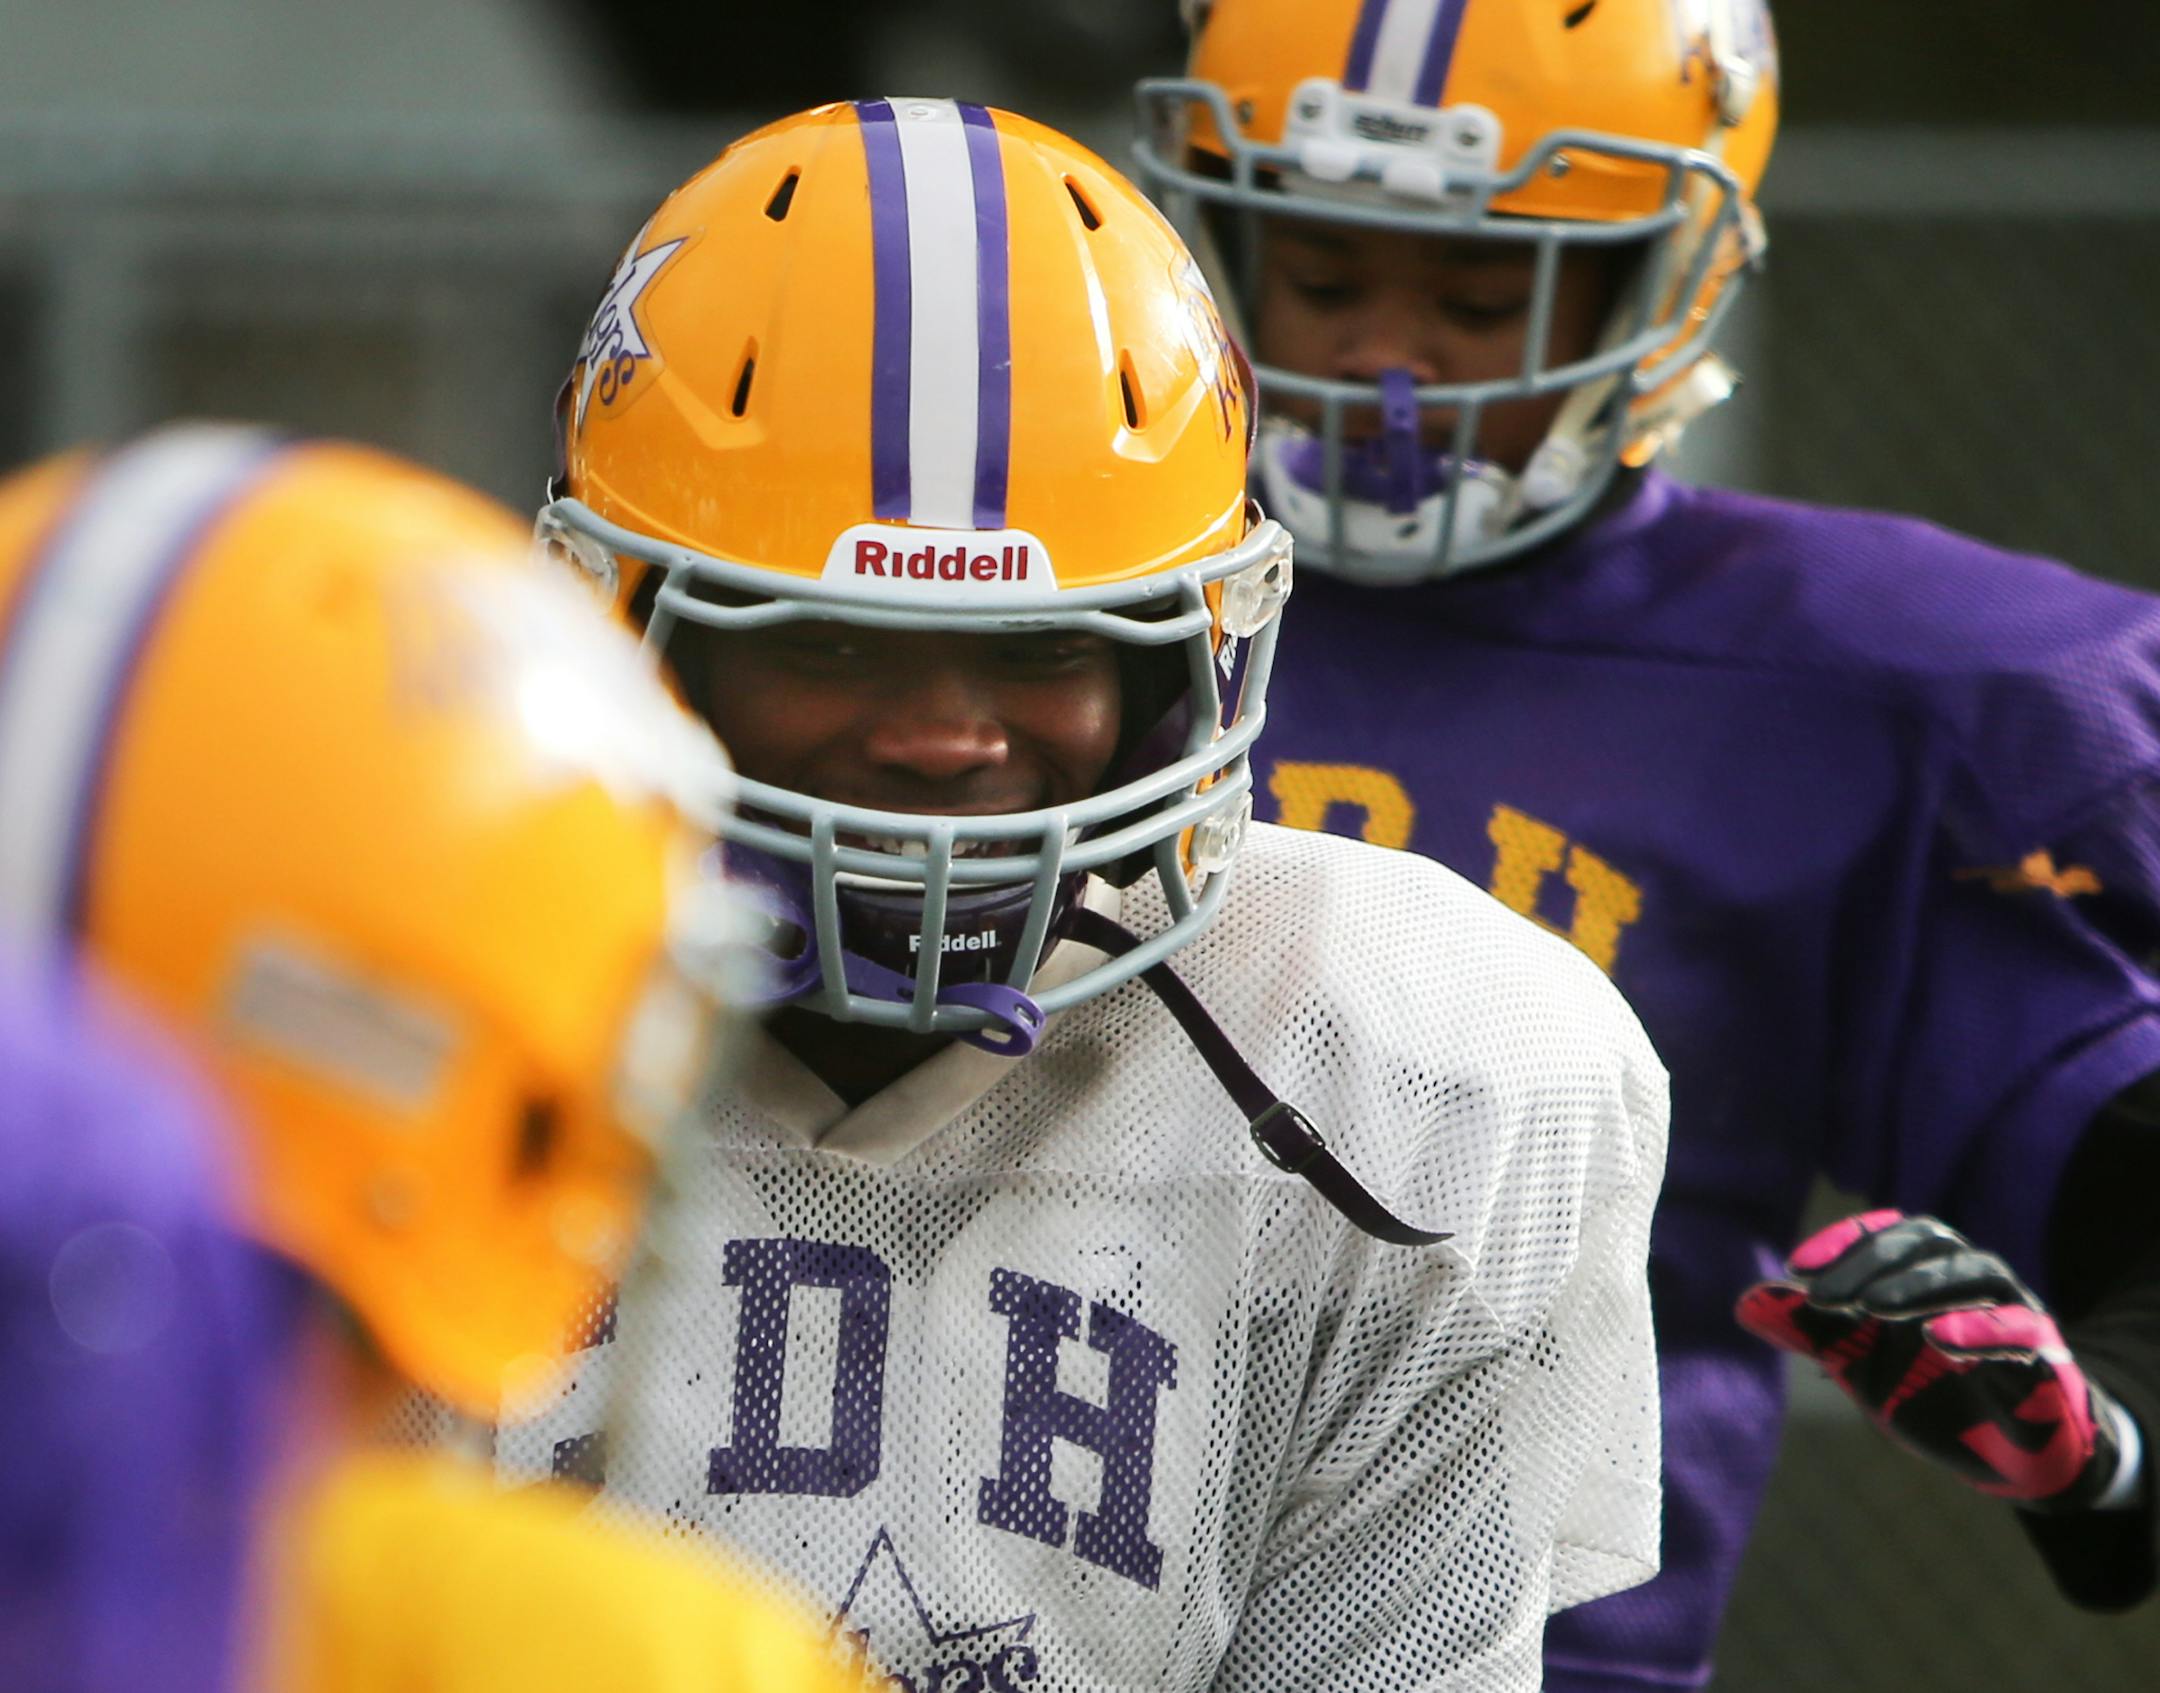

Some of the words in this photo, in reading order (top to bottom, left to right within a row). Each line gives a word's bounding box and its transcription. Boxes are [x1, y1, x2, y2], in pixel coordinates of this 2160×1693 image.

[854, 539, 1029, 582] Riddell
[908, 929, 997, 953] Rddell
[553, 1238, 1178, 1594] DH
